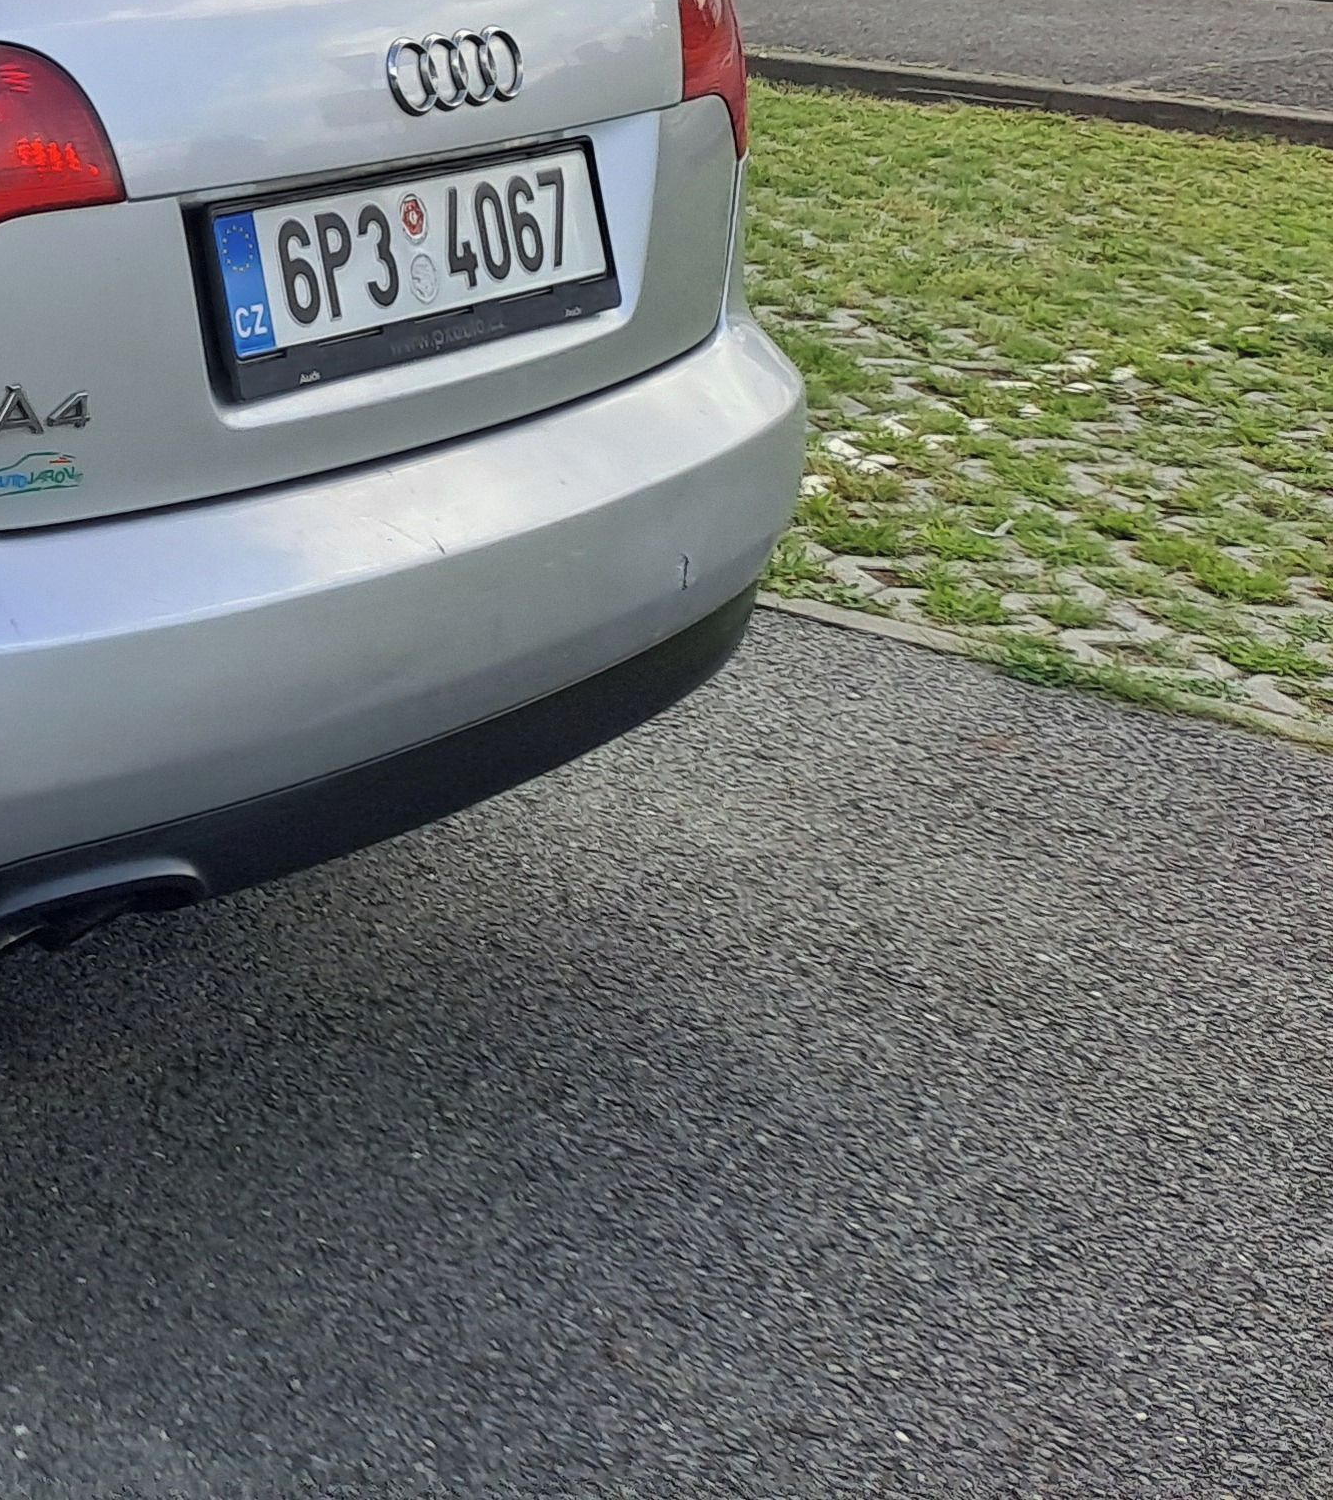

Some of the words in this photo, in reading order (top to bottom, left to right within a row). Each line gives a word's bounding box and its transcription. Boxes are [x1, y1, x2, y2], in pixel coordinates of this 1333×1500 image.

[278, 204, 400, 326] 6P3
[448, 167, 565, 289] 4067
[235, 303, 268, 338] CZ
